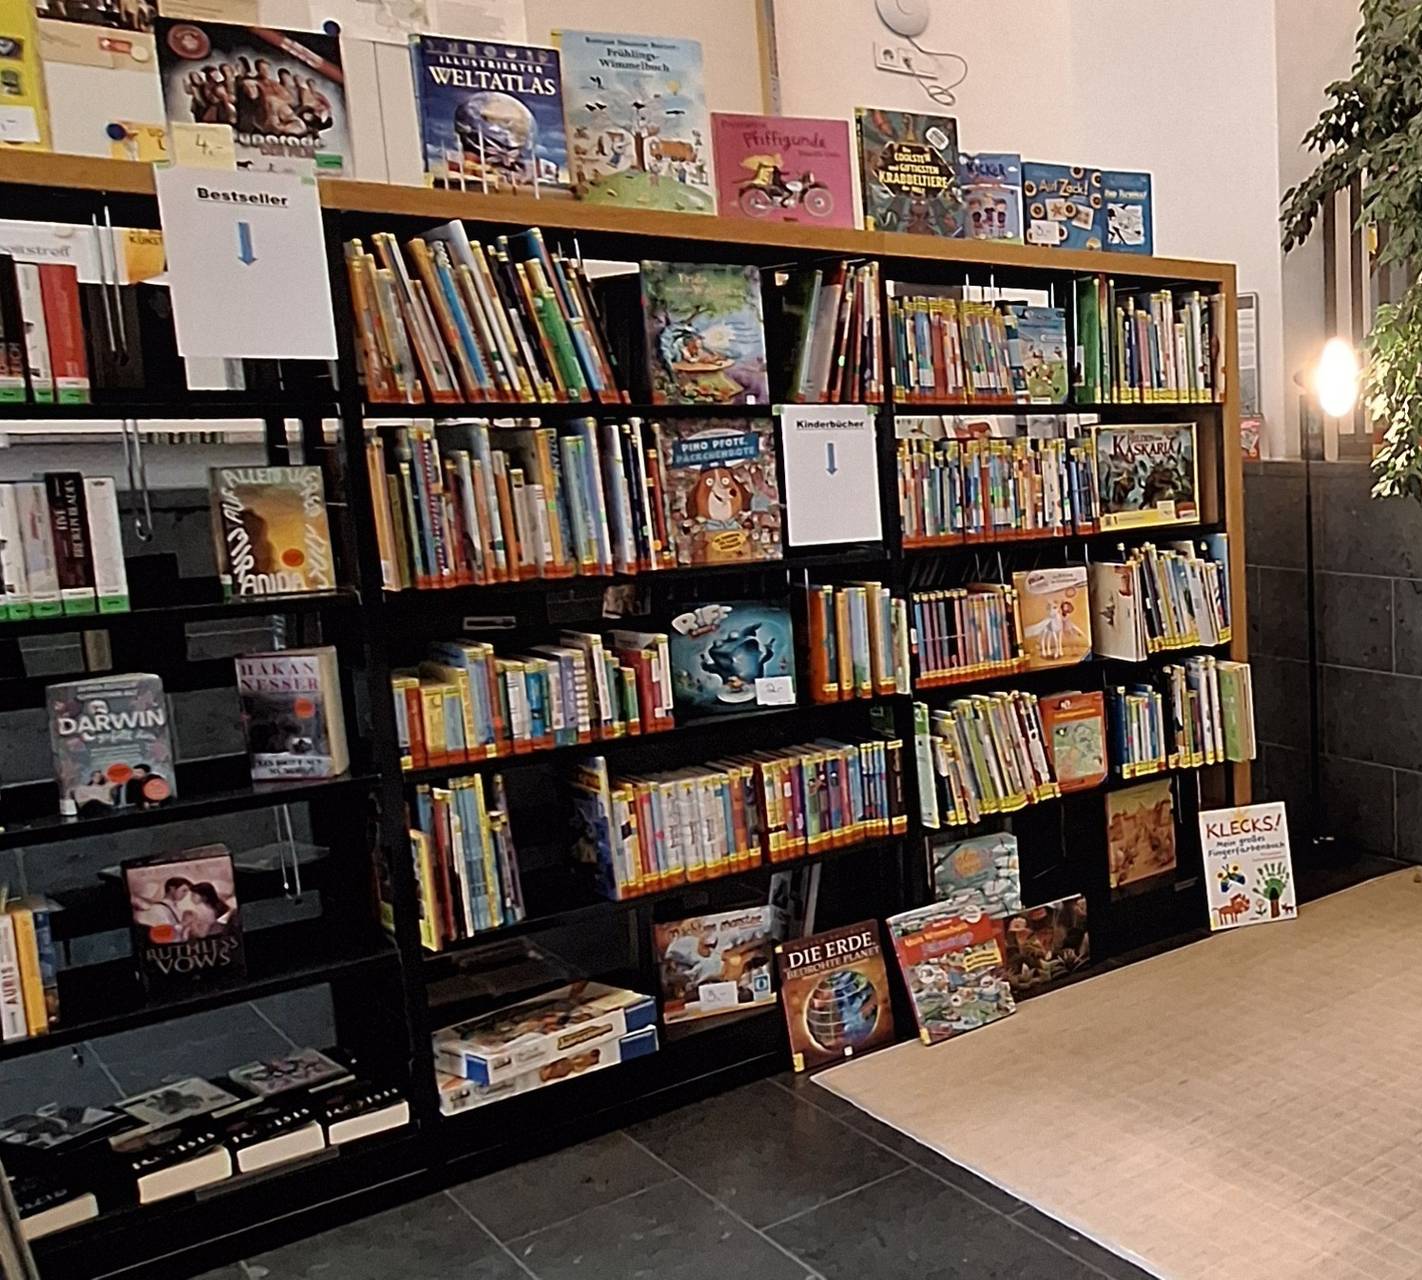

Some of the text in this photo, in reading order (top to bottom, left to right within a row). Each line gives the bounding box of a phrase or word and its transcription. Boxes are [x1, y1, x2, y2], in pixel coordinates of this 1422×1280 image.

[438, 55, 544, 75] ILLUSTRIERTER
[428, 65, 557, 96] WELTATLAS
[879, 170, 949, 189] KRABBELTIERE
[1038, 181, 1057, 194] Auf
[1059, 178, 1089, 196] Zack!
[196, 186, 288, 207] Bestseller
[796, 420, 865, 430] Kinderbücher
[681, 441, 709, 452] PINO
[58, 708, 165, 736] DARWIN
[1206, 813, 1282, 839] KLECKS!
[1238, 835, 1266, 846] großes
[157, 954, 231, 975] VOWS
[788, 947, 822, 969] DIE
